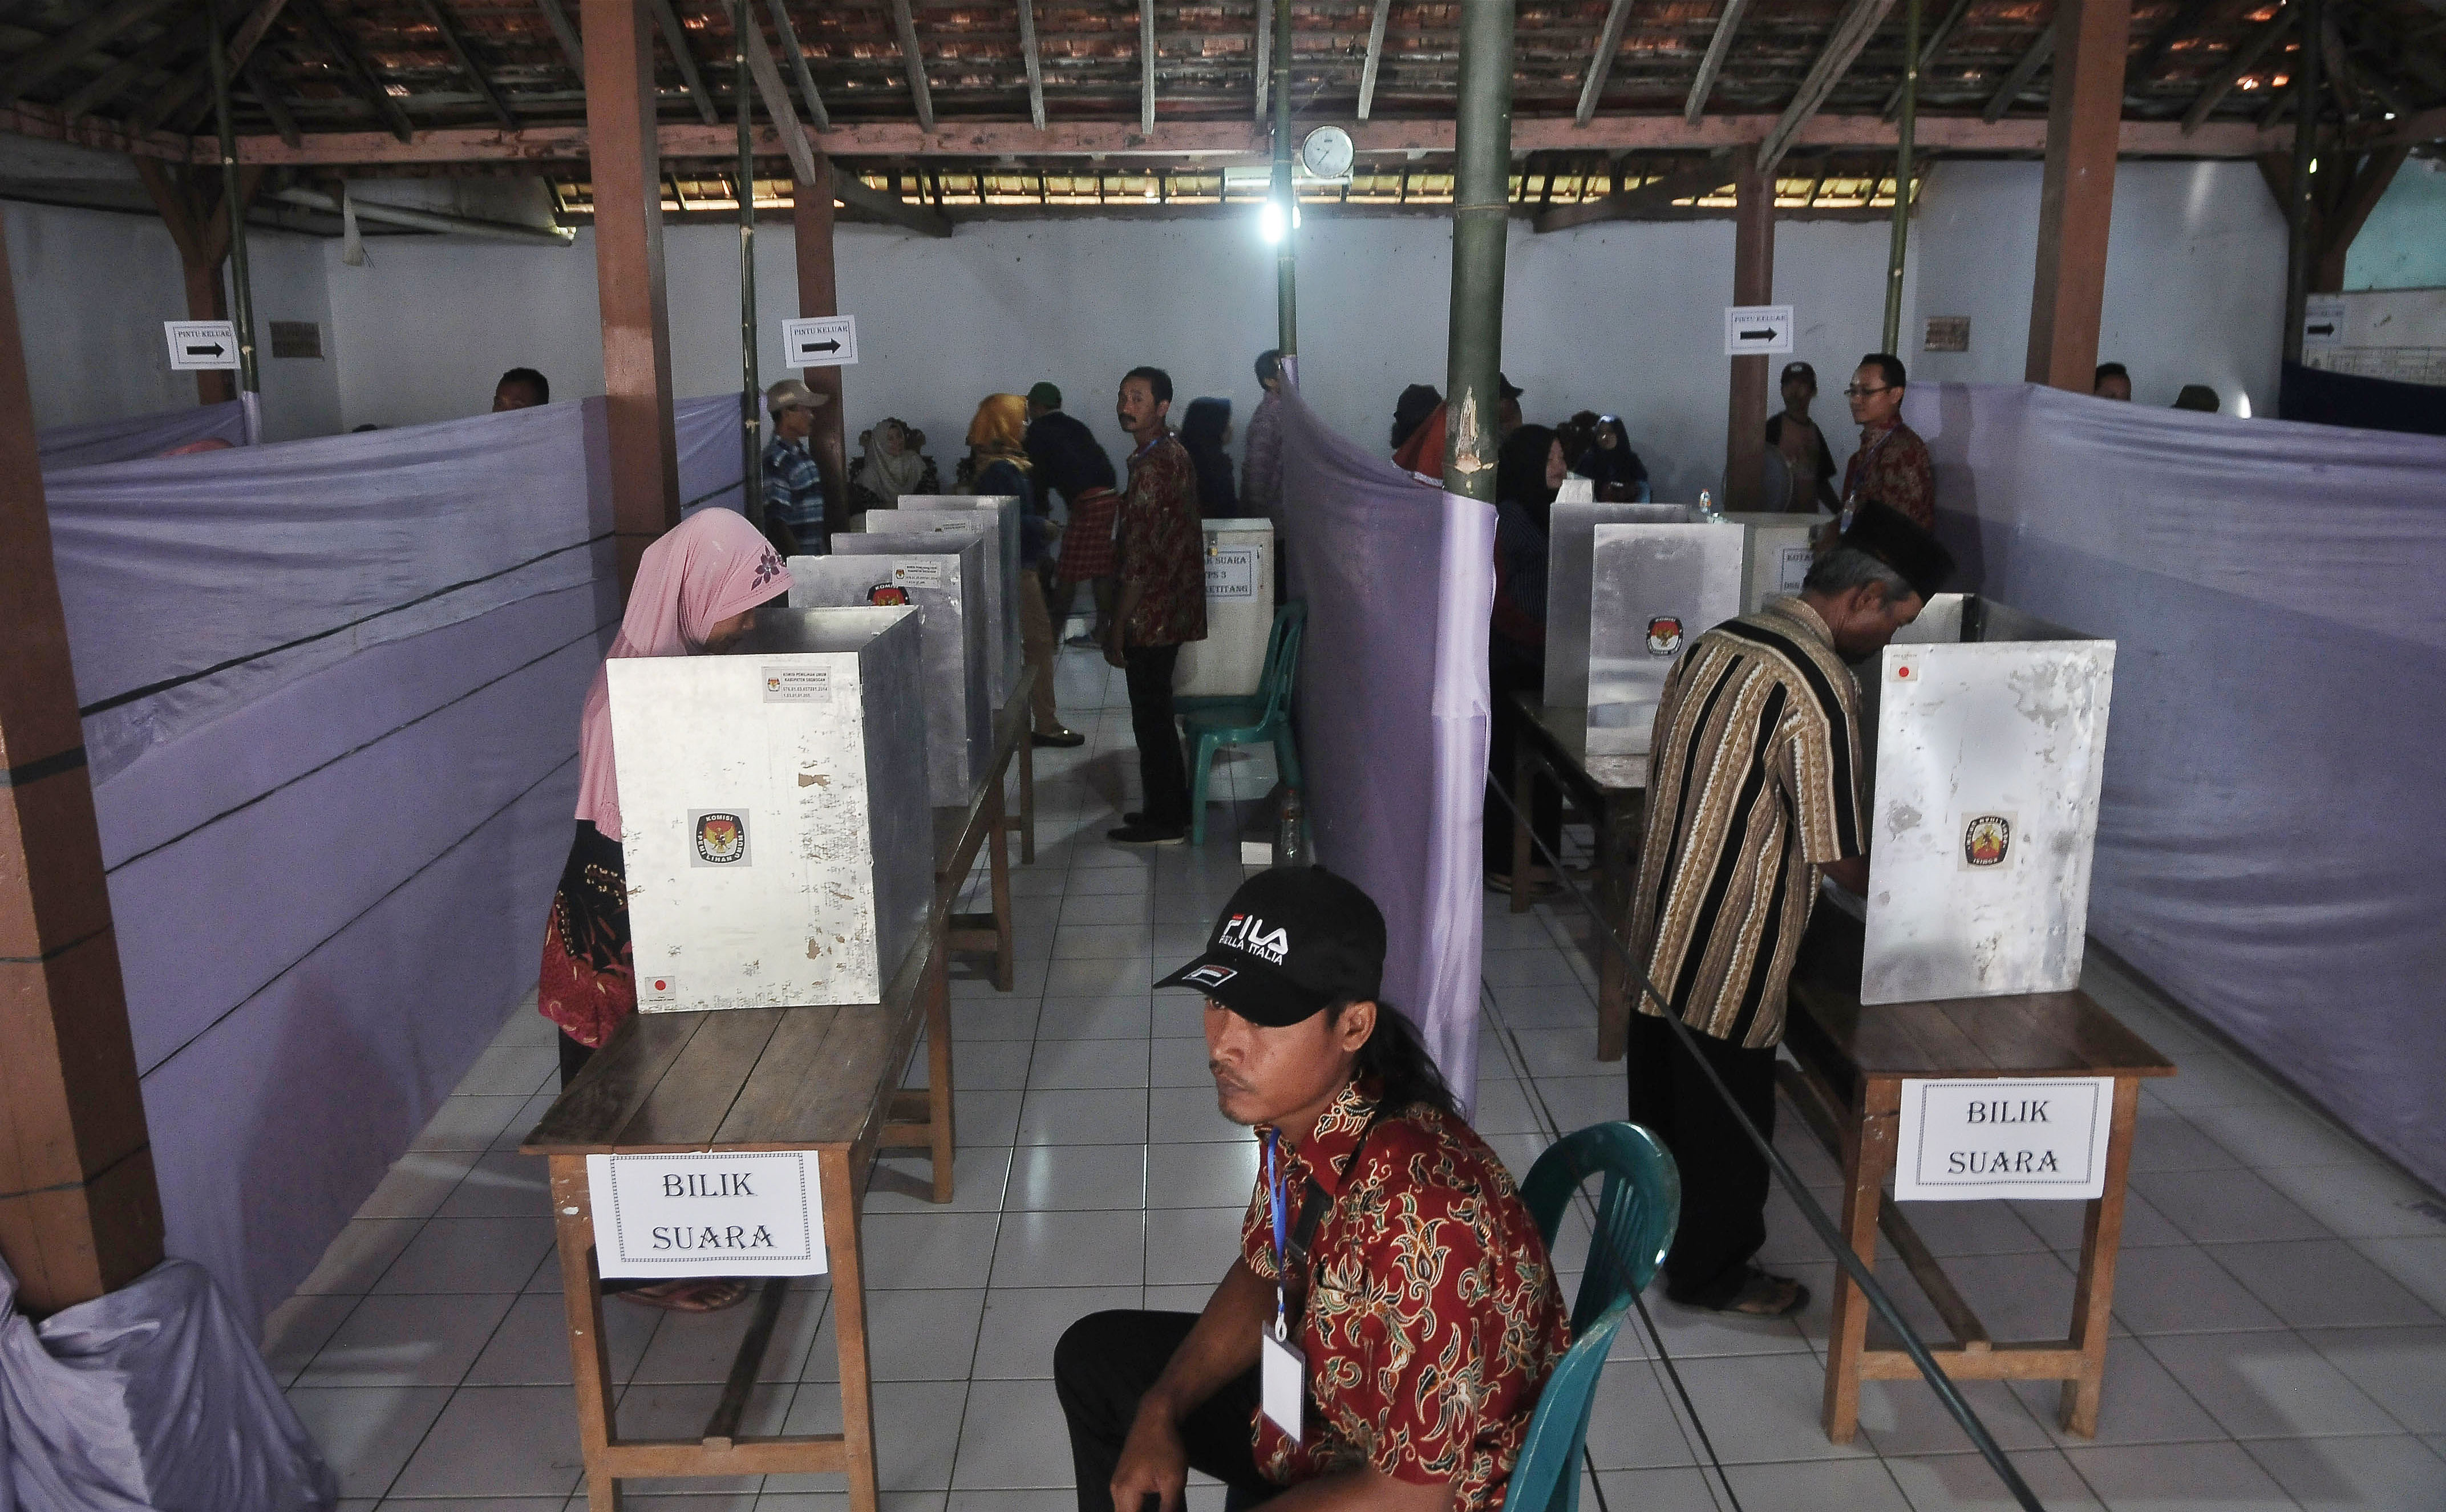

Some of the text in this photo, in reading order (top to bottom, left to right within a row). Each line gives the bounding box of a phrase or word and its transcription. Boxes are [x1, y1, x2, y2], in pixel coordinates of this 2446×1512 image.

[734, 835, 743, 858] UMUM
[1224, 914, 1289, 955] FILA
[1248, 943, 1282, 966] ITALIA
[1967, 1100, 2050, 1124] BILIK
[1947, 1150, 2058, 1174] SUARA
[662, 1172, 756, 1197] BILIK
[652, 1225, 776, 1250] SUARA
